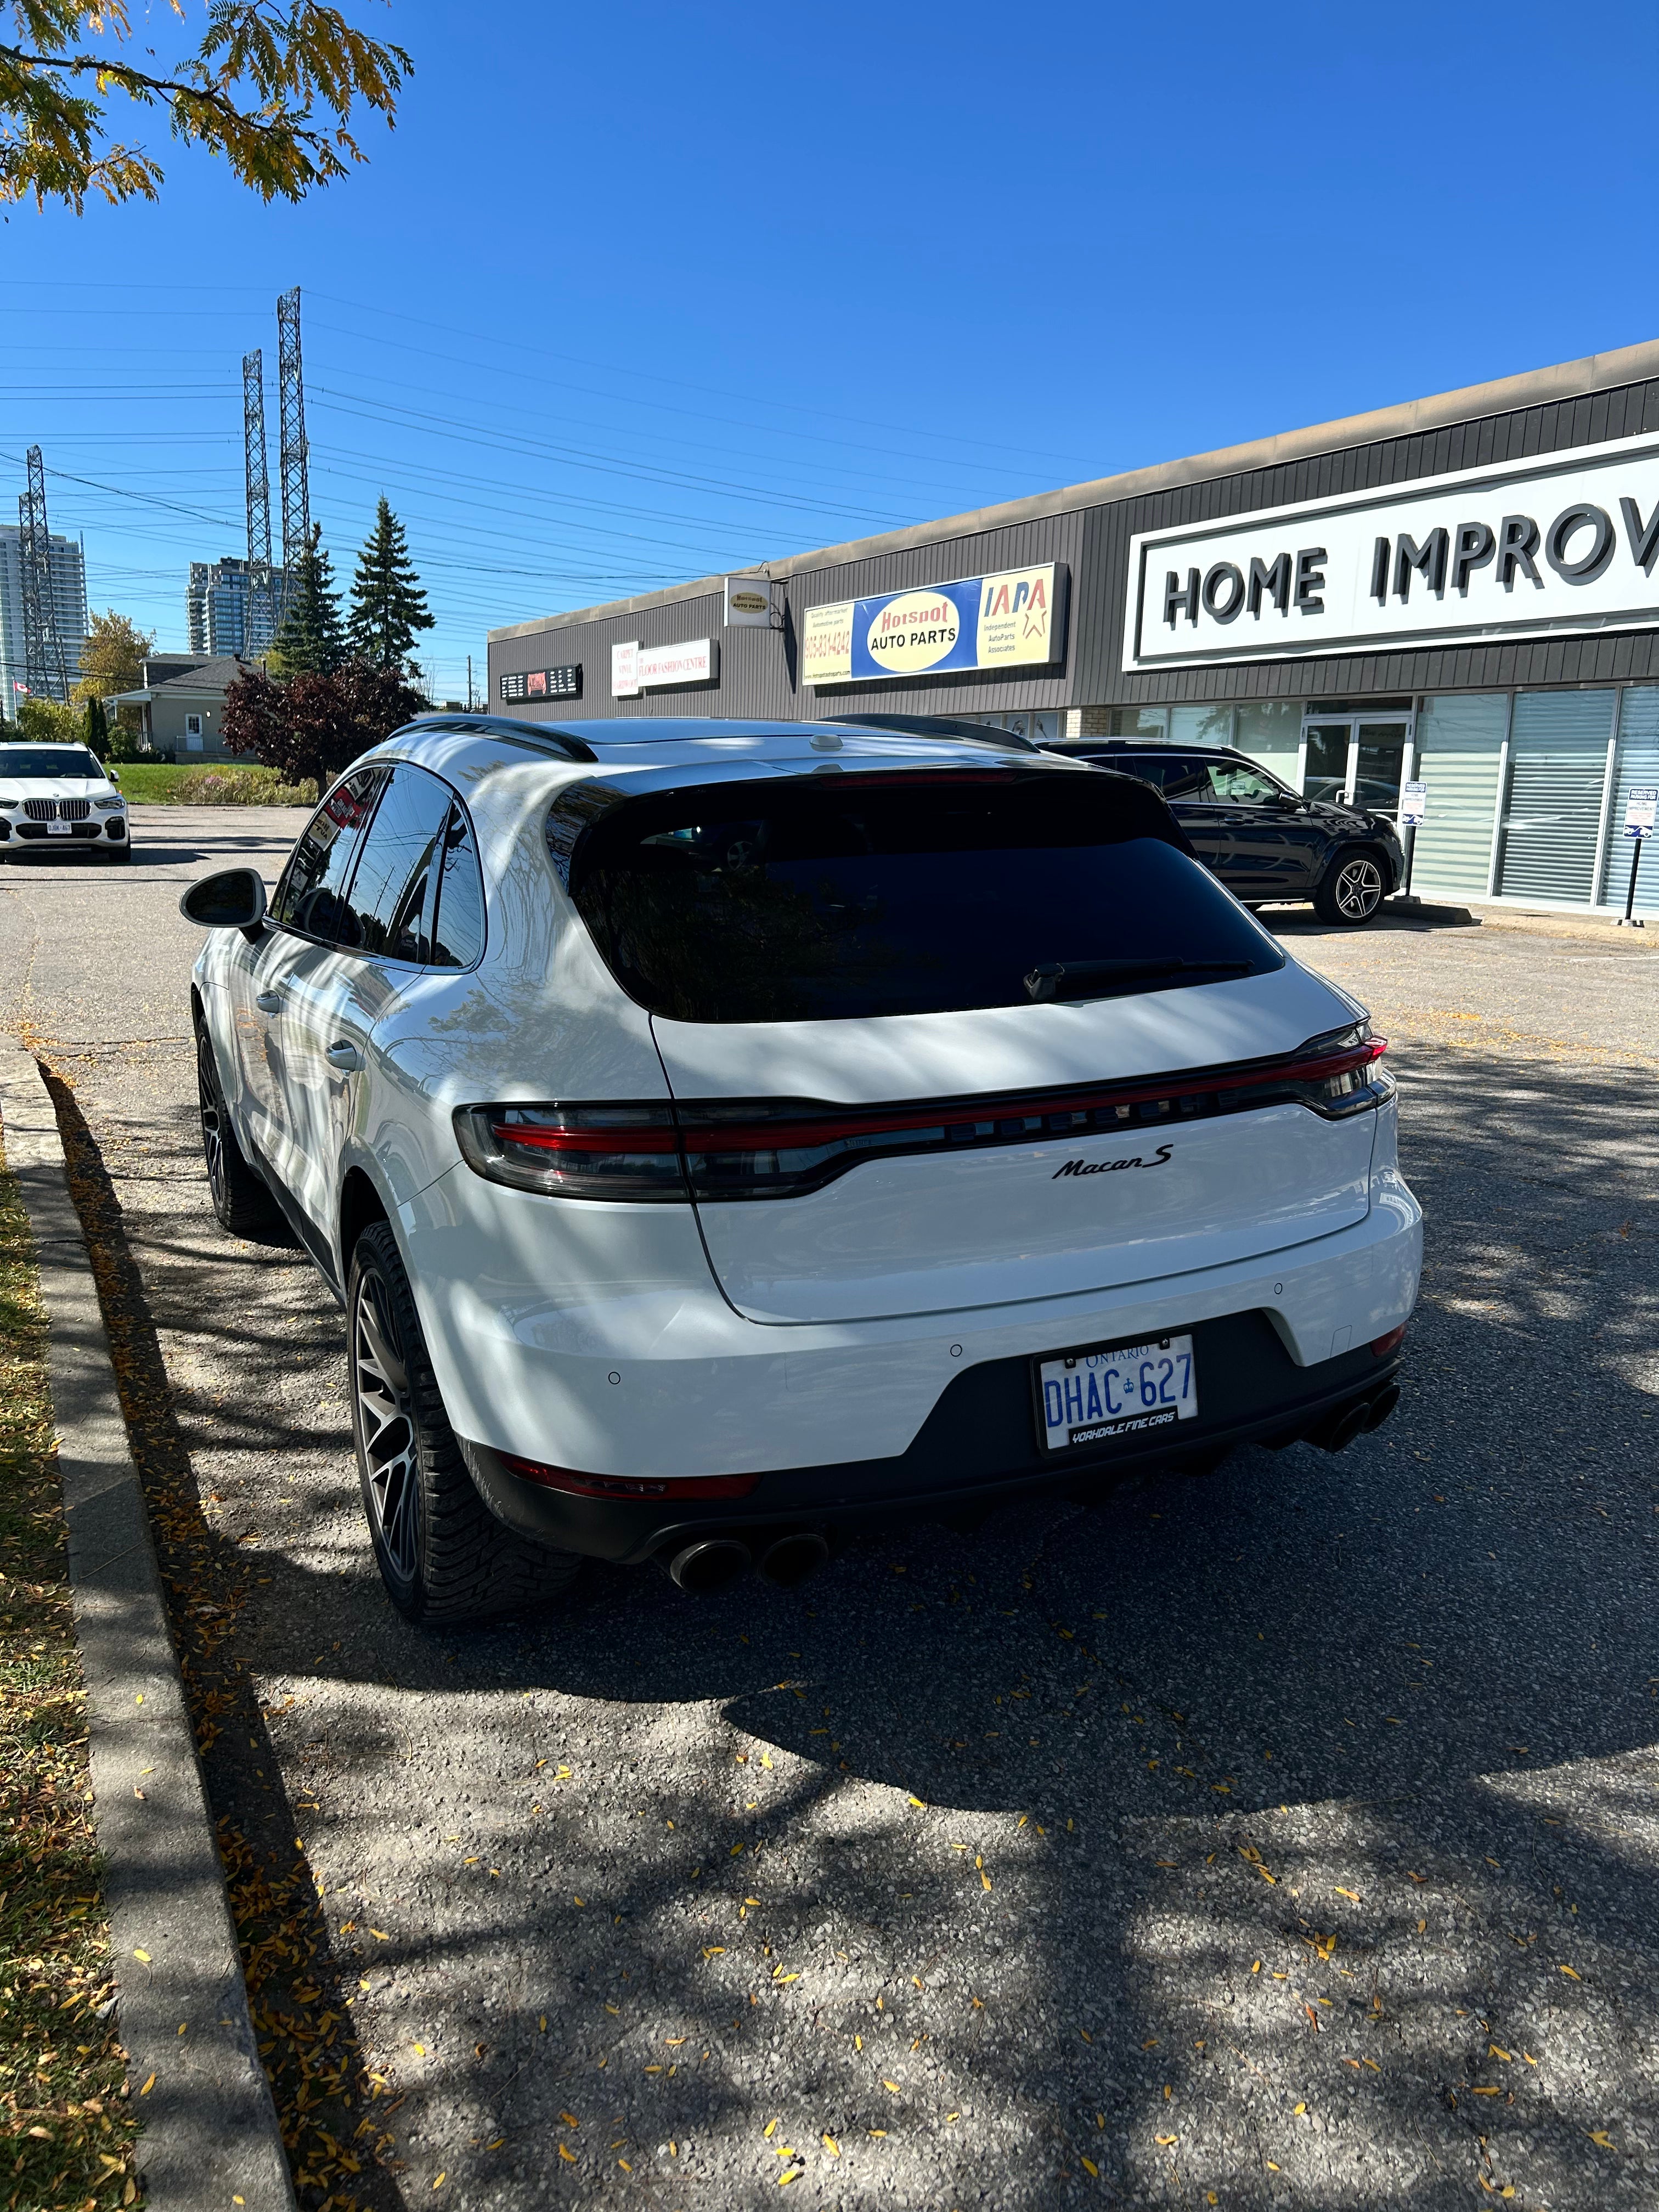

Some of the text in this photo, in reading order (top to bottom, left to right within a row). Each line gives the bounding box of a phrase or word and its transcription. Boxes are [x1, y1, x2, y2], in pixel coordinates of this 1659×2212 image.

[984, 579, 1046, 617] IAPA
[1163, 546, 1327, 625] HOME
[881, 601, 948, 633] Hotspot
[984, 622, 1016, 631] Independent
[617, 648, 634, 659] CARPET
[805, 631, 850, 659] 905-831-4242
[871, 628, 956, 651] AUTO PARTS
[988, 645, 1015, 653] Associates
[639, 656, 707, 676] FLOOR FASHION CENTRE
[1052, 1144, 1173, 1179] Macan S
[1086, 1345, 1149, 1368] ONTARIO
[1044, 1353, 1191, 1427] DHAC 627
[1073, 1411, 1176, 1443] YORKDALE FINE CARS
